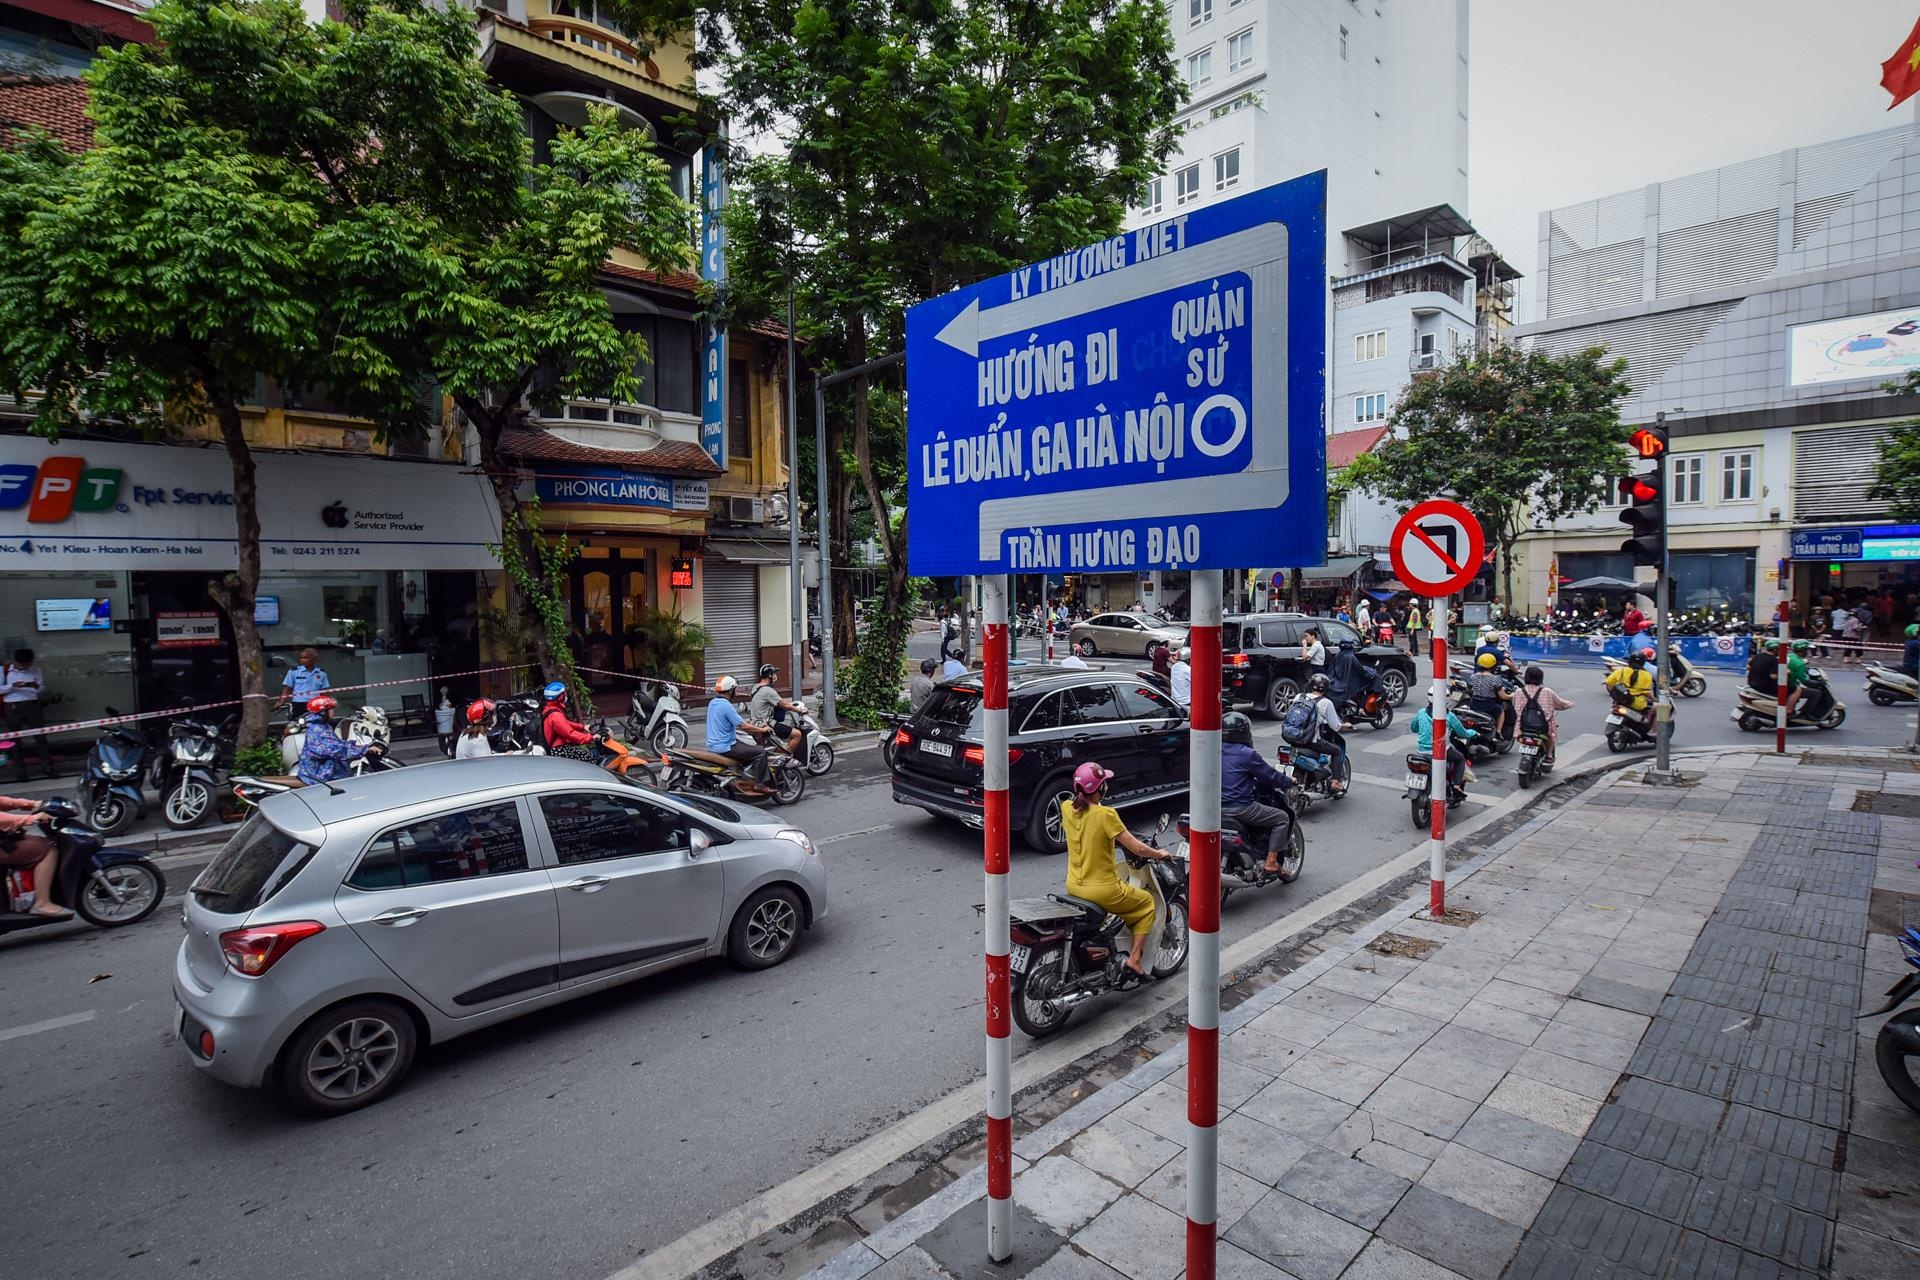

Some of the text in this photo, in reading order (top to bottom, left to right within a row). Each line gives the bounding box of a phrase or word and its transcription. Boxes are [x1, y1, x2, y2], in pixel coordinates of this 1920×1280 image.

[1172, 280, 1245, 343] QUÁN
[978, 328, 1118, 407] HƯỚNG ĐI
[1187, 333, 1228, 388] SỨ
[704, 422, 721, 436] PHONG
[708, 443, 719, 456] LAN
[923, 431, 950, 487] LÊ
[1077, 403, 1118, 469] HÀ
[1125, 392, 1184, 473] NỘI
[0, 474, 115, 501] FPT
[132, 486, 236, 506] Fpt Servic
[554, 480, 671, 503] PHONG LAN HOTEL
[354, 511, 403, 520] Authorized
[354, 521, 425, 531] Service Provider
[36, 545, 57, 553] Yet
[271, 546, 360, 555] Tel: 0243 211 5274
[1008, 524, 1200, 570] TRẦN HƯNG ĐẠO
[1841, 543, 1859, 555] ĐẠO
